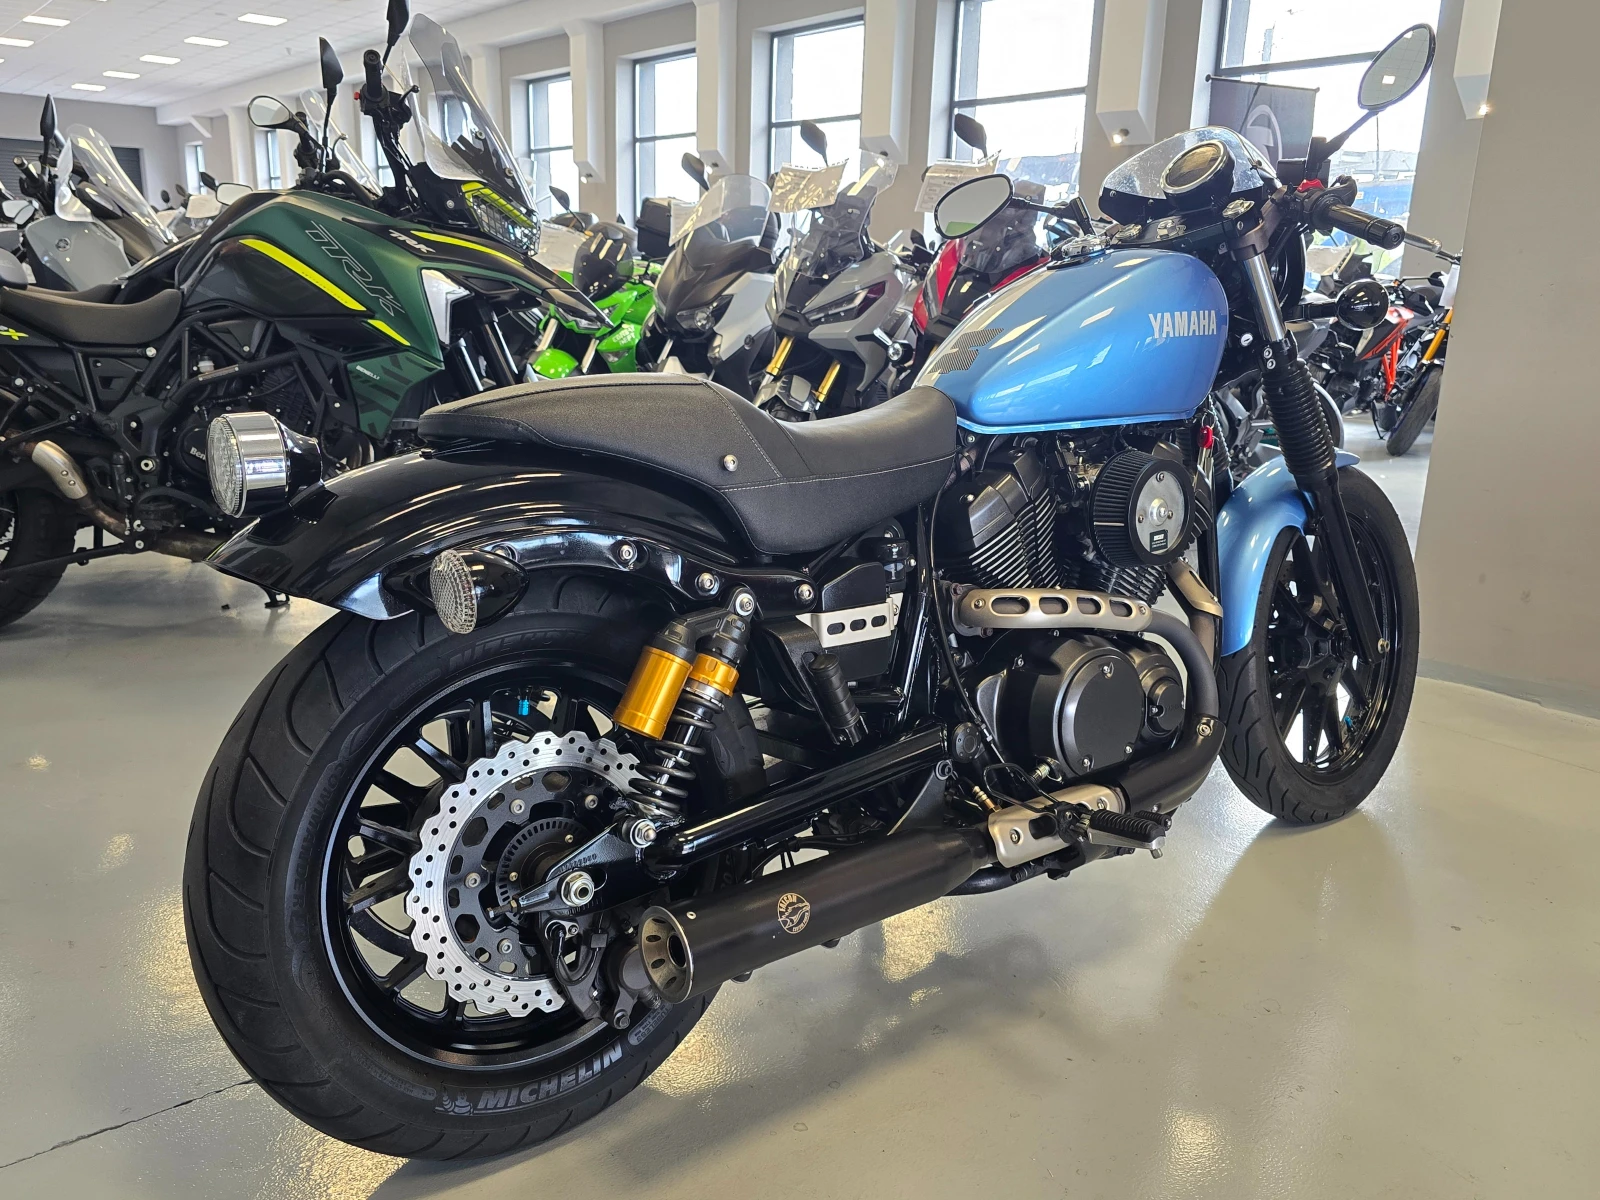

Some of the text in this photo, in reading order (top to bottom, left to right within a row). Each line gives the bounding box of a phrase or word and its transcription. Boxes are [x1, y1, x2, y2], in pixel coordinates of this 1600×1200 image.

[305, 220, 406, 317] TRK
[388, 229, 436, 253] TRK
[1148, 310, 1217, 339] YAMAHA
[293, 759, 346, 908] COMMANDER
[477, 1042, 623, 1109] MICHELIN
